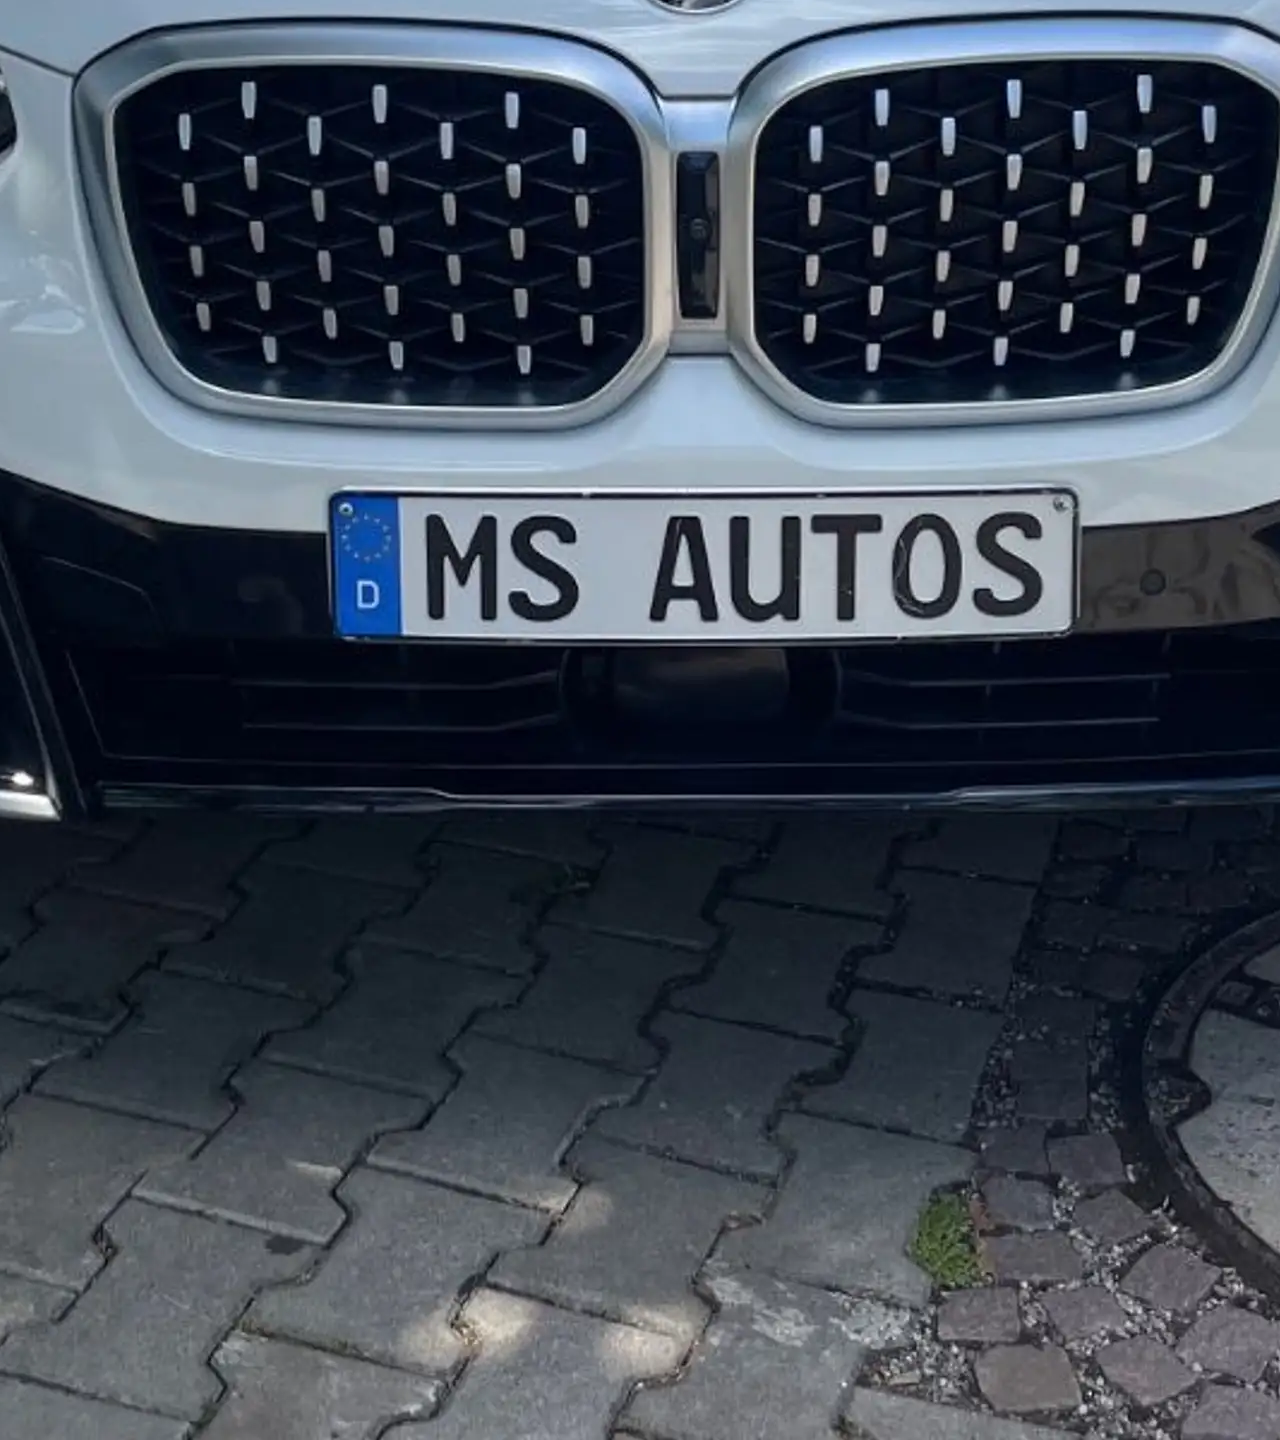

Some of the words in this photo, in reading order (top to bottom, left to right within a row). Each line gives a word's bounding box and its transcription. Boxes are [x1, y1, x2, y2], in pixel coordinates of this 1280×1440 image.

[356, 579, 380, 610] D
[425, 514, 580, 622] MS
[648, 513, 1044, 622] AUTOS
